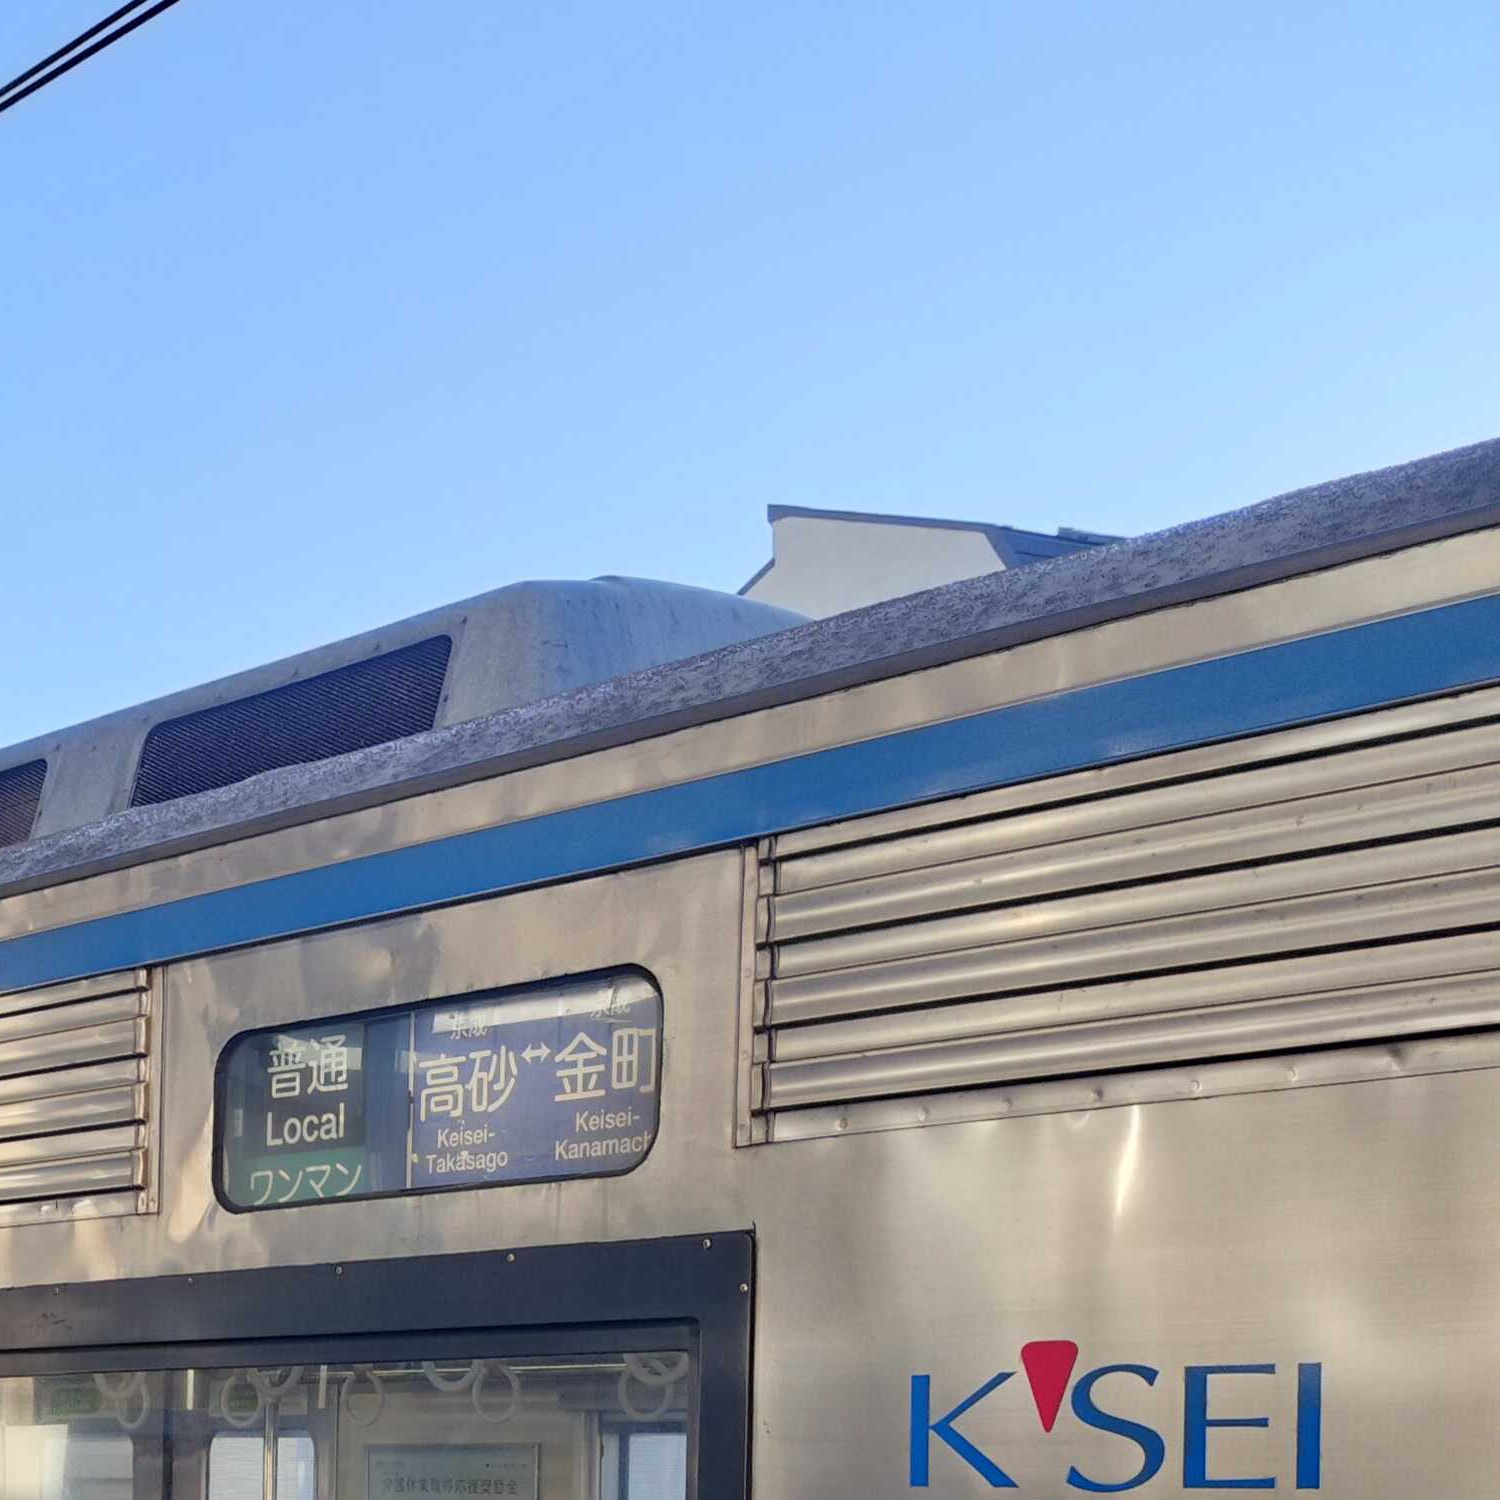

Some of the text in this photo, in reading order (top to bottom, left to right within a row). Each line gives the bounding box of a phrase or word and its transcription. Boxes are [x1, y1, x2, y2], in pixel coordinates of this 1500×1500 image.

[267, 1034, 349, 1099] 普通
[419, 1027, 657, 1122] 高砂 金町
[266, 1102, 345, 1147] Local
[436, 1124, 496, 1149] Keisei-
[575, 1110, 640, 1133] Keisei-
[250, 1162, 362, 1206] ワンマン
[425, 1150, 509, 1175] Takasago
